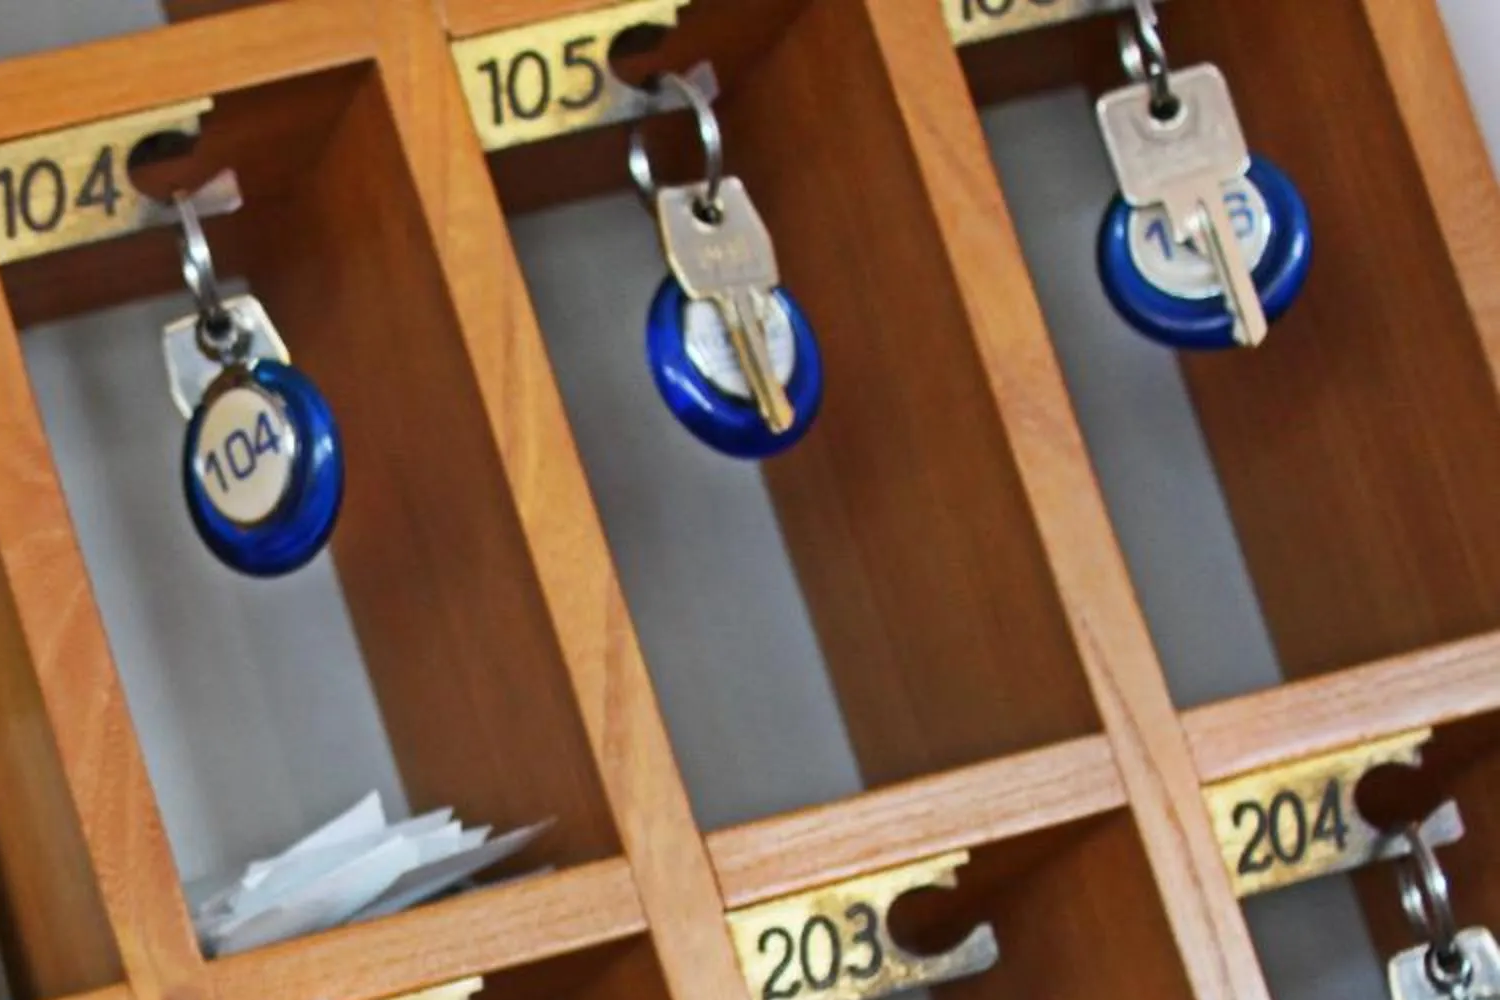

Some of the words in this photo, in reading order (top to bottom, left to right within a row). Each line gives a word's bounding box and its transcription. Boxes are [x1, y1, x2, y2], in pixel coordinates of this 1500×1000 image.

[476, 35, 605, 126] 105
[1143, 188, 1255, 261] 16
[204, 411, 281, 494] 104
[1231, 776, 1349, 876] 204
